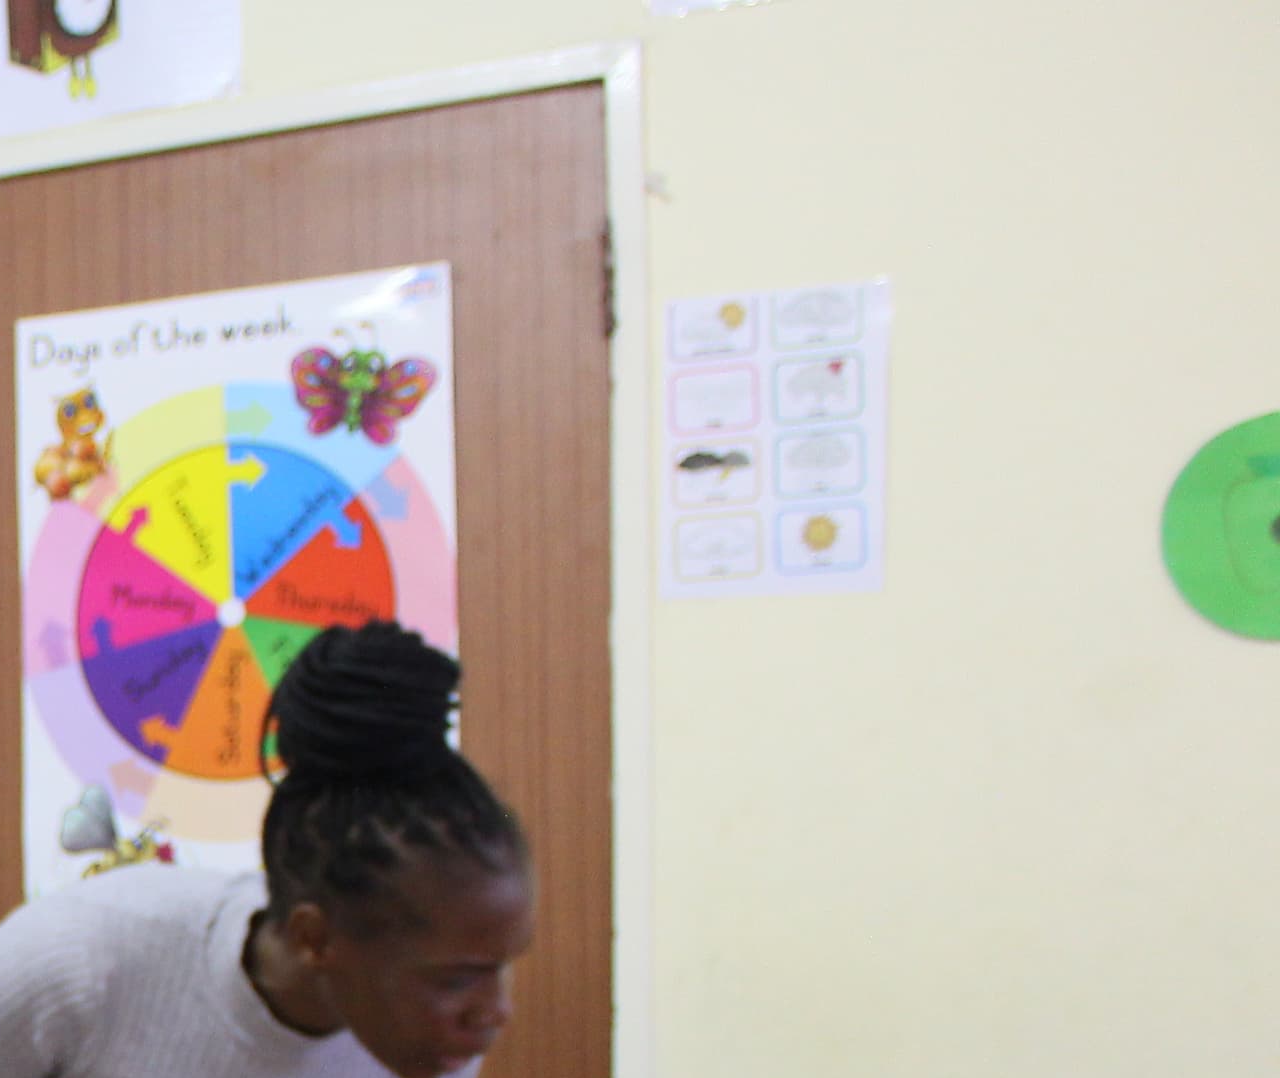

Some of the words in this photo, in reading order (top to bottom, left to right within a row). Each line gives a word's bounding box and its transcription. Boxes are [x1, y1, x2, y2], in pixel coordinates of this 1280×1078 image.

[29, 333, 103, 377] Days
[112, 319, 148, 356] of
[151, 316, 208, 353] the
[219, 305, 293, 343] week
